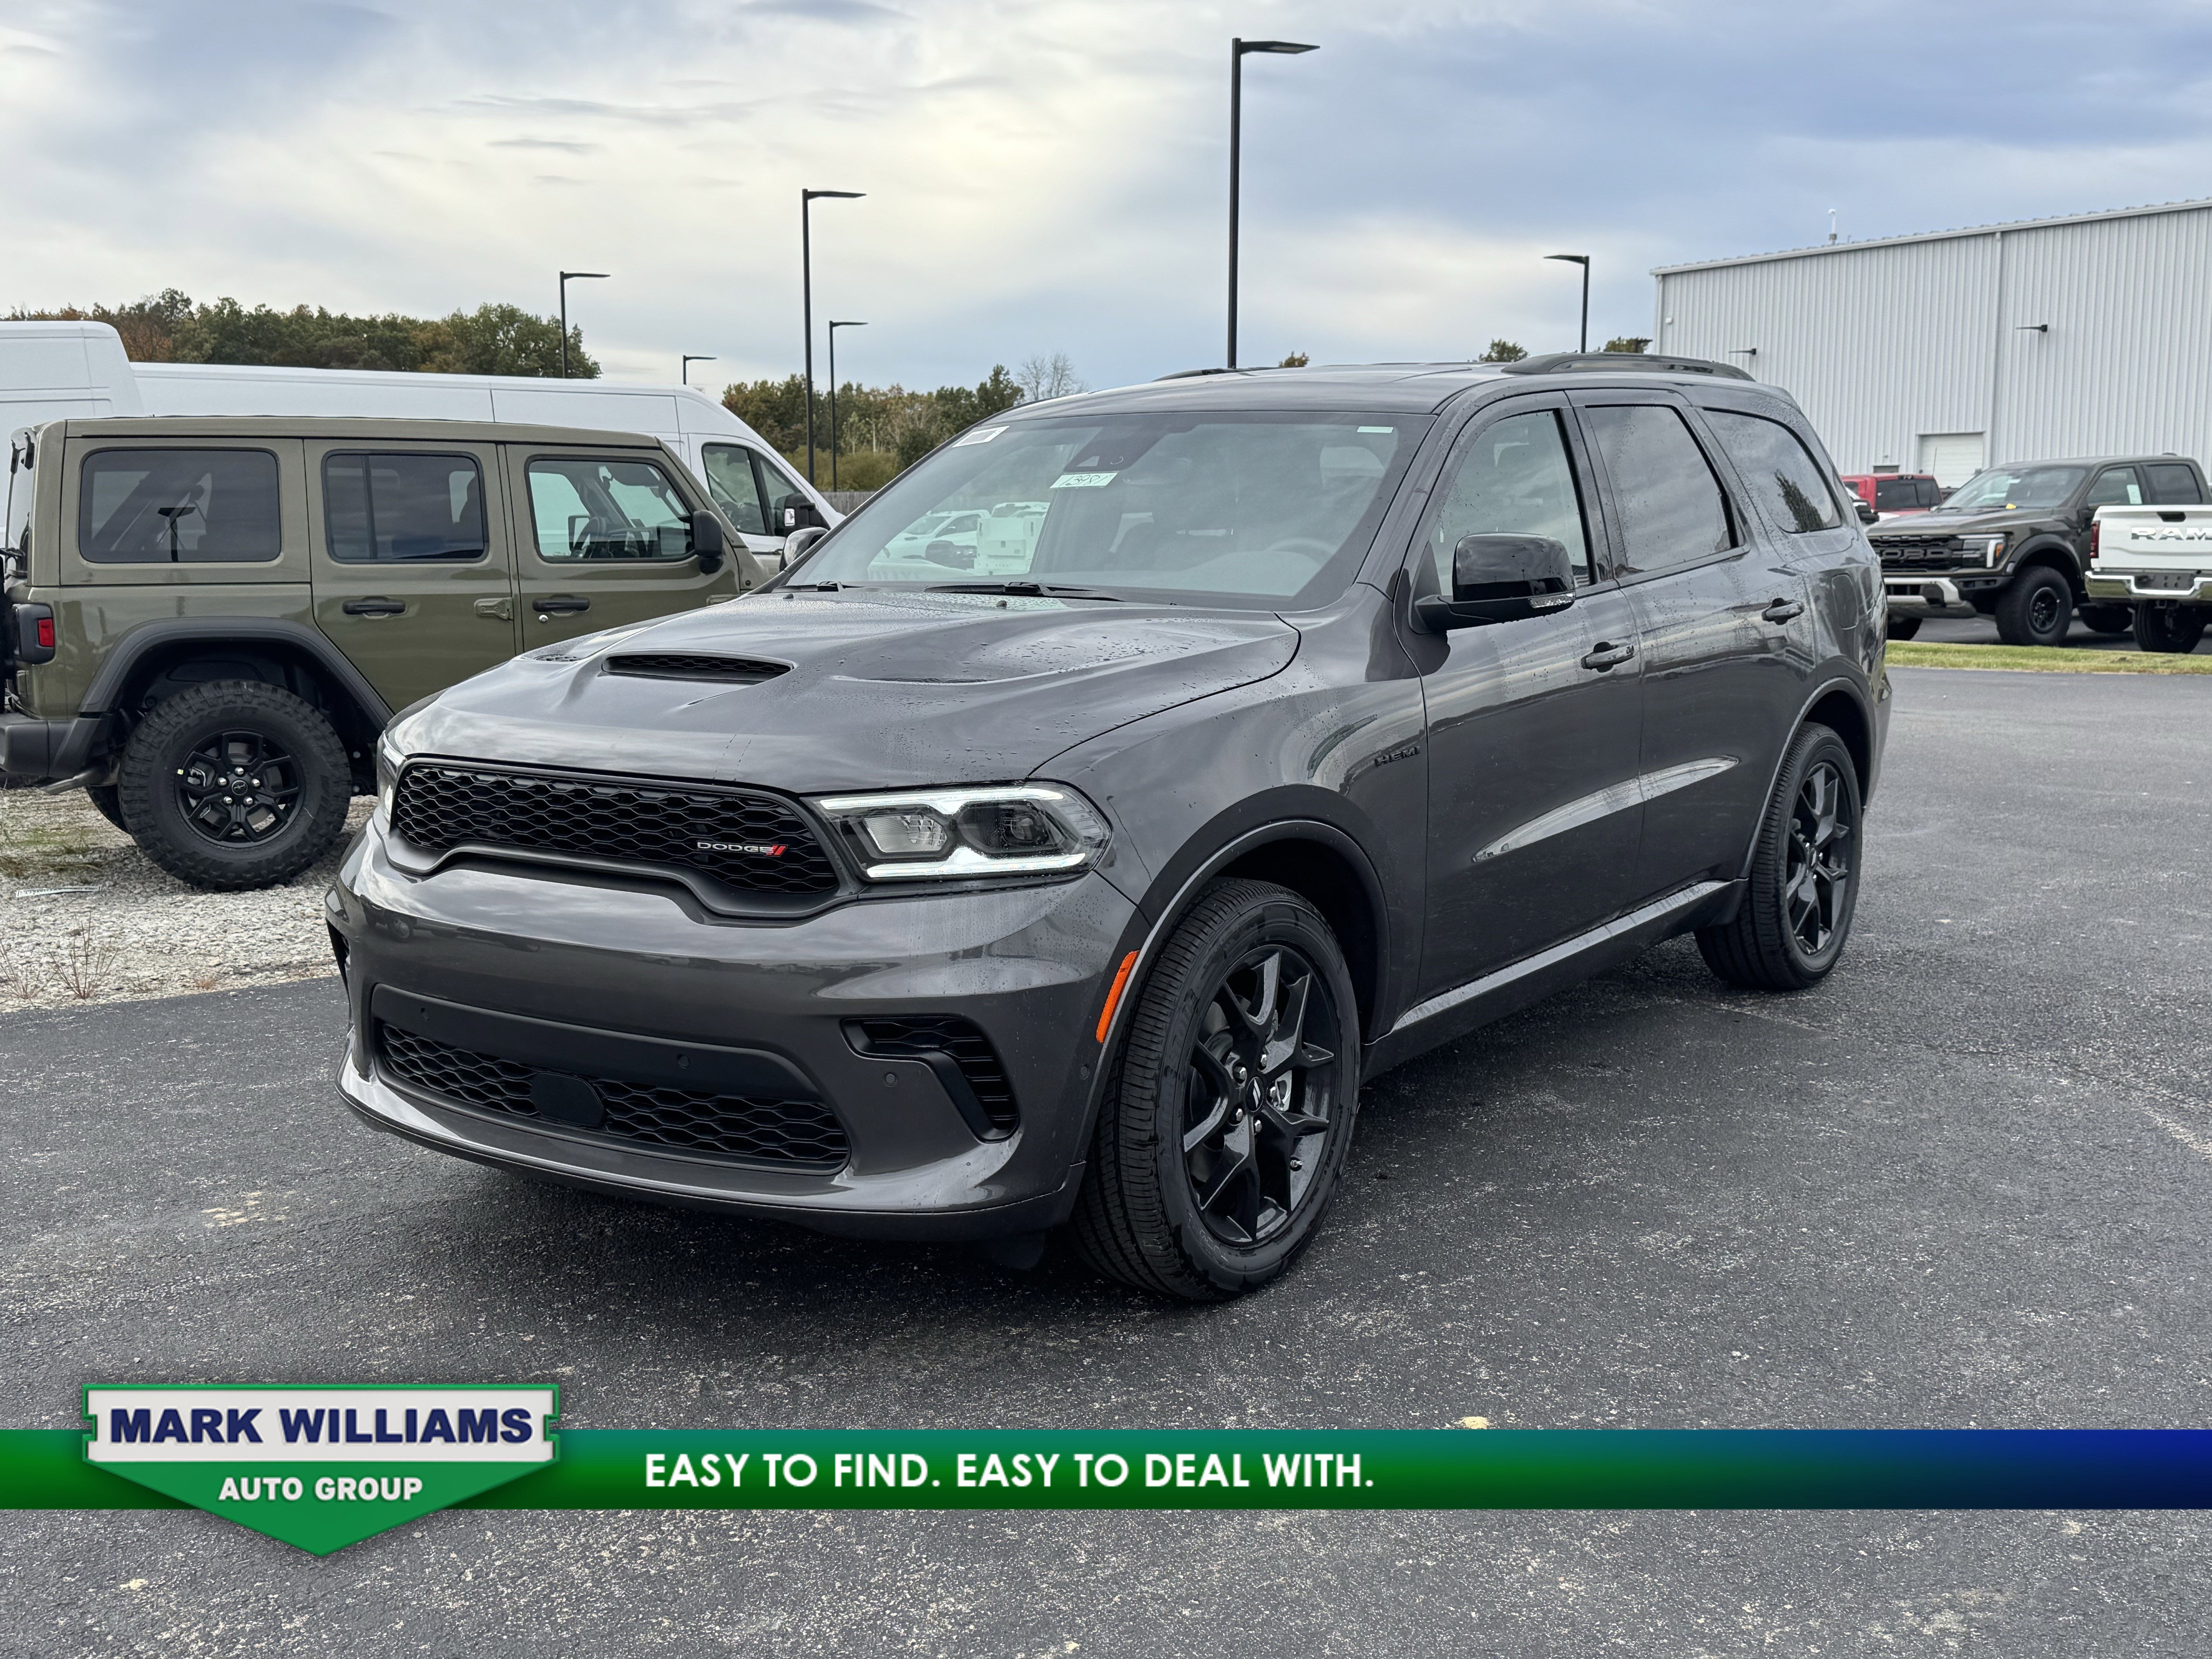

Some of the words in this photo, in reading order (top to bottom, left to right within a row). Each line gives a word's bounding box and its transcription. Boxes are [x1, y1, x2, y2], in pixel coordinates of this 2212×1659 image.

[2131, 527, 2212, 541] RAM
[1875, 548, 1952, 560] ORD
[697, 842, 774, 854] DODGE
